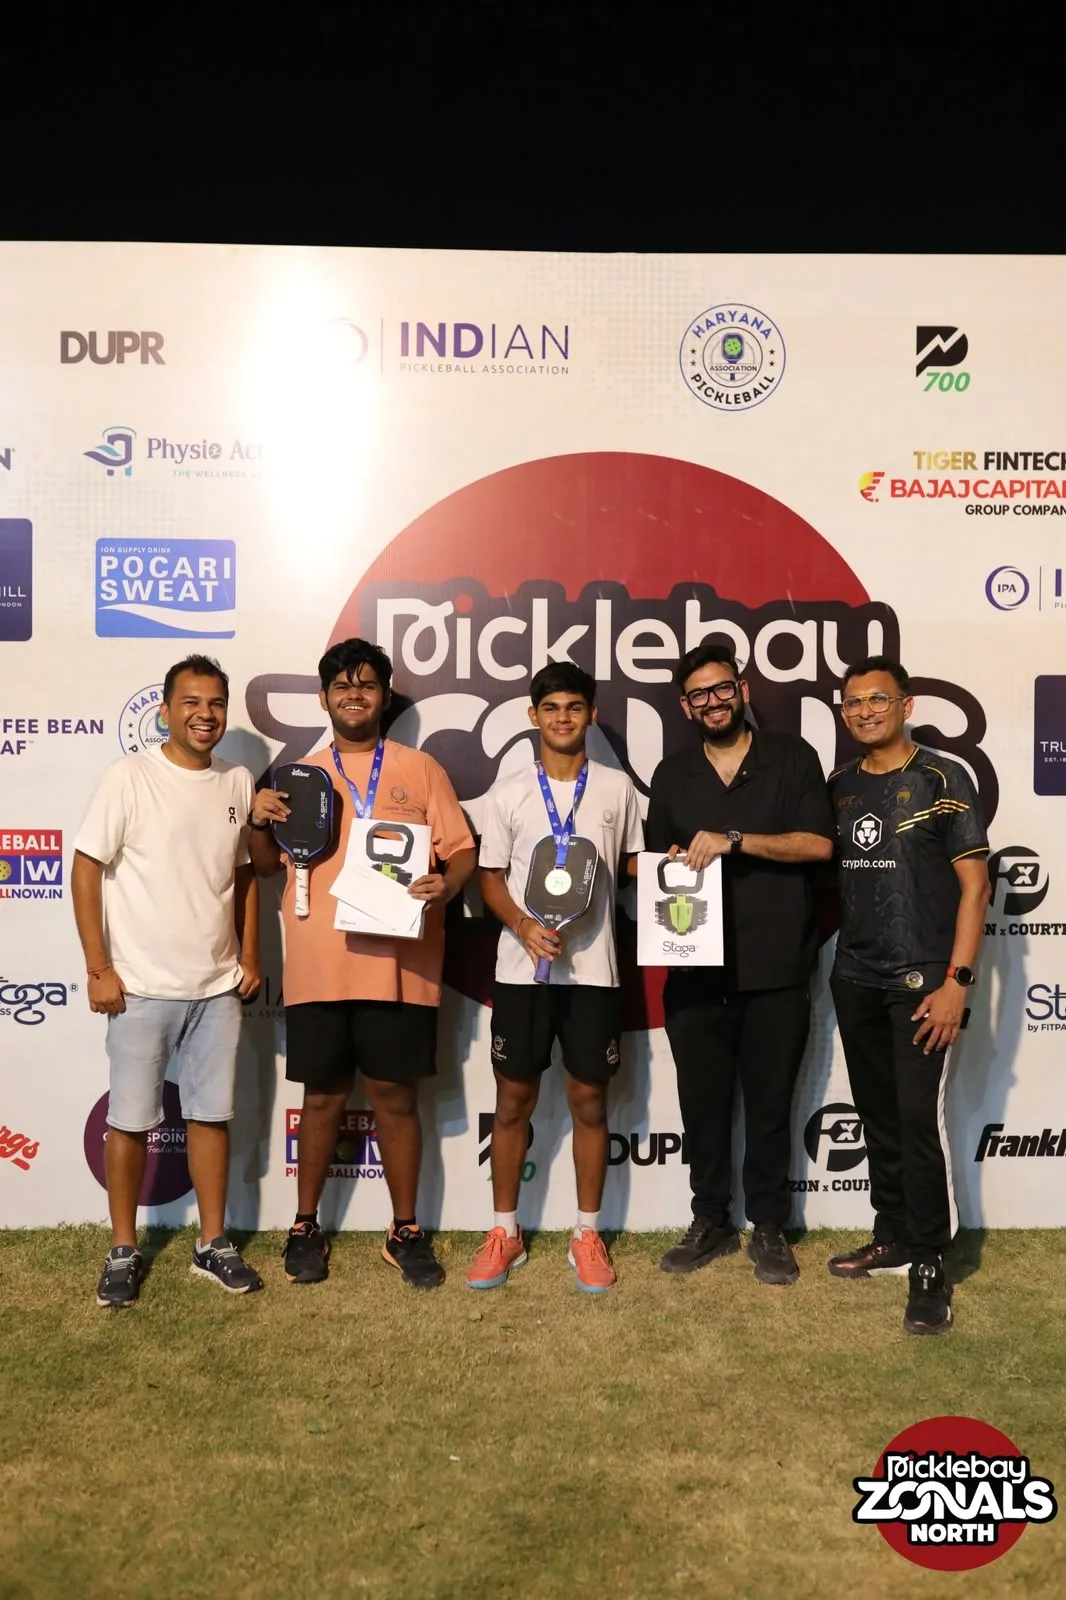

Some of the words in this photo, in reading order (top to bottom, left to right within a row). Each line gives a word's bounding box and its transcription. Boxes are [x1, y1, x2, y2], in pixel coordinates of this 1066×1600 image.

[692, 310, 772, 340] HARYANA
[60, 330, 166, 365] DUPR
[401, 321, 569, 360] INDIAN
[400, 363, 477, 373] PICKLEBALL
[482, 365, 569, 375] ASSOCIATION
[709, 364, 758, 372] ASSOCIATION
[690, 372, 776, 405] PICKLEBALL
[923, 372, 971, 392] 700
[146, 437, 223, 465] Physio
[912, 450, 979, 470] TIGER
[965, 504, 1010, 516] GROUP
[117, 546, 146, 554] SUPPLY
[100, 555, 231, 579] POCARI
[100, 579, 219, 602] SWEAT
[997, 583, 1017, 593] IPA
[129, 689, 164, 714] HAR
[0, 718, 39, 734] FEE
[47, 719, 104, 735] BEAN
[0, 834, 60, 851] EBALL
[842, 858, 896, 870] crypto.com
[1009, 923, 1066, 936] COURT
[1027, 1023, 1039, 1033] by
